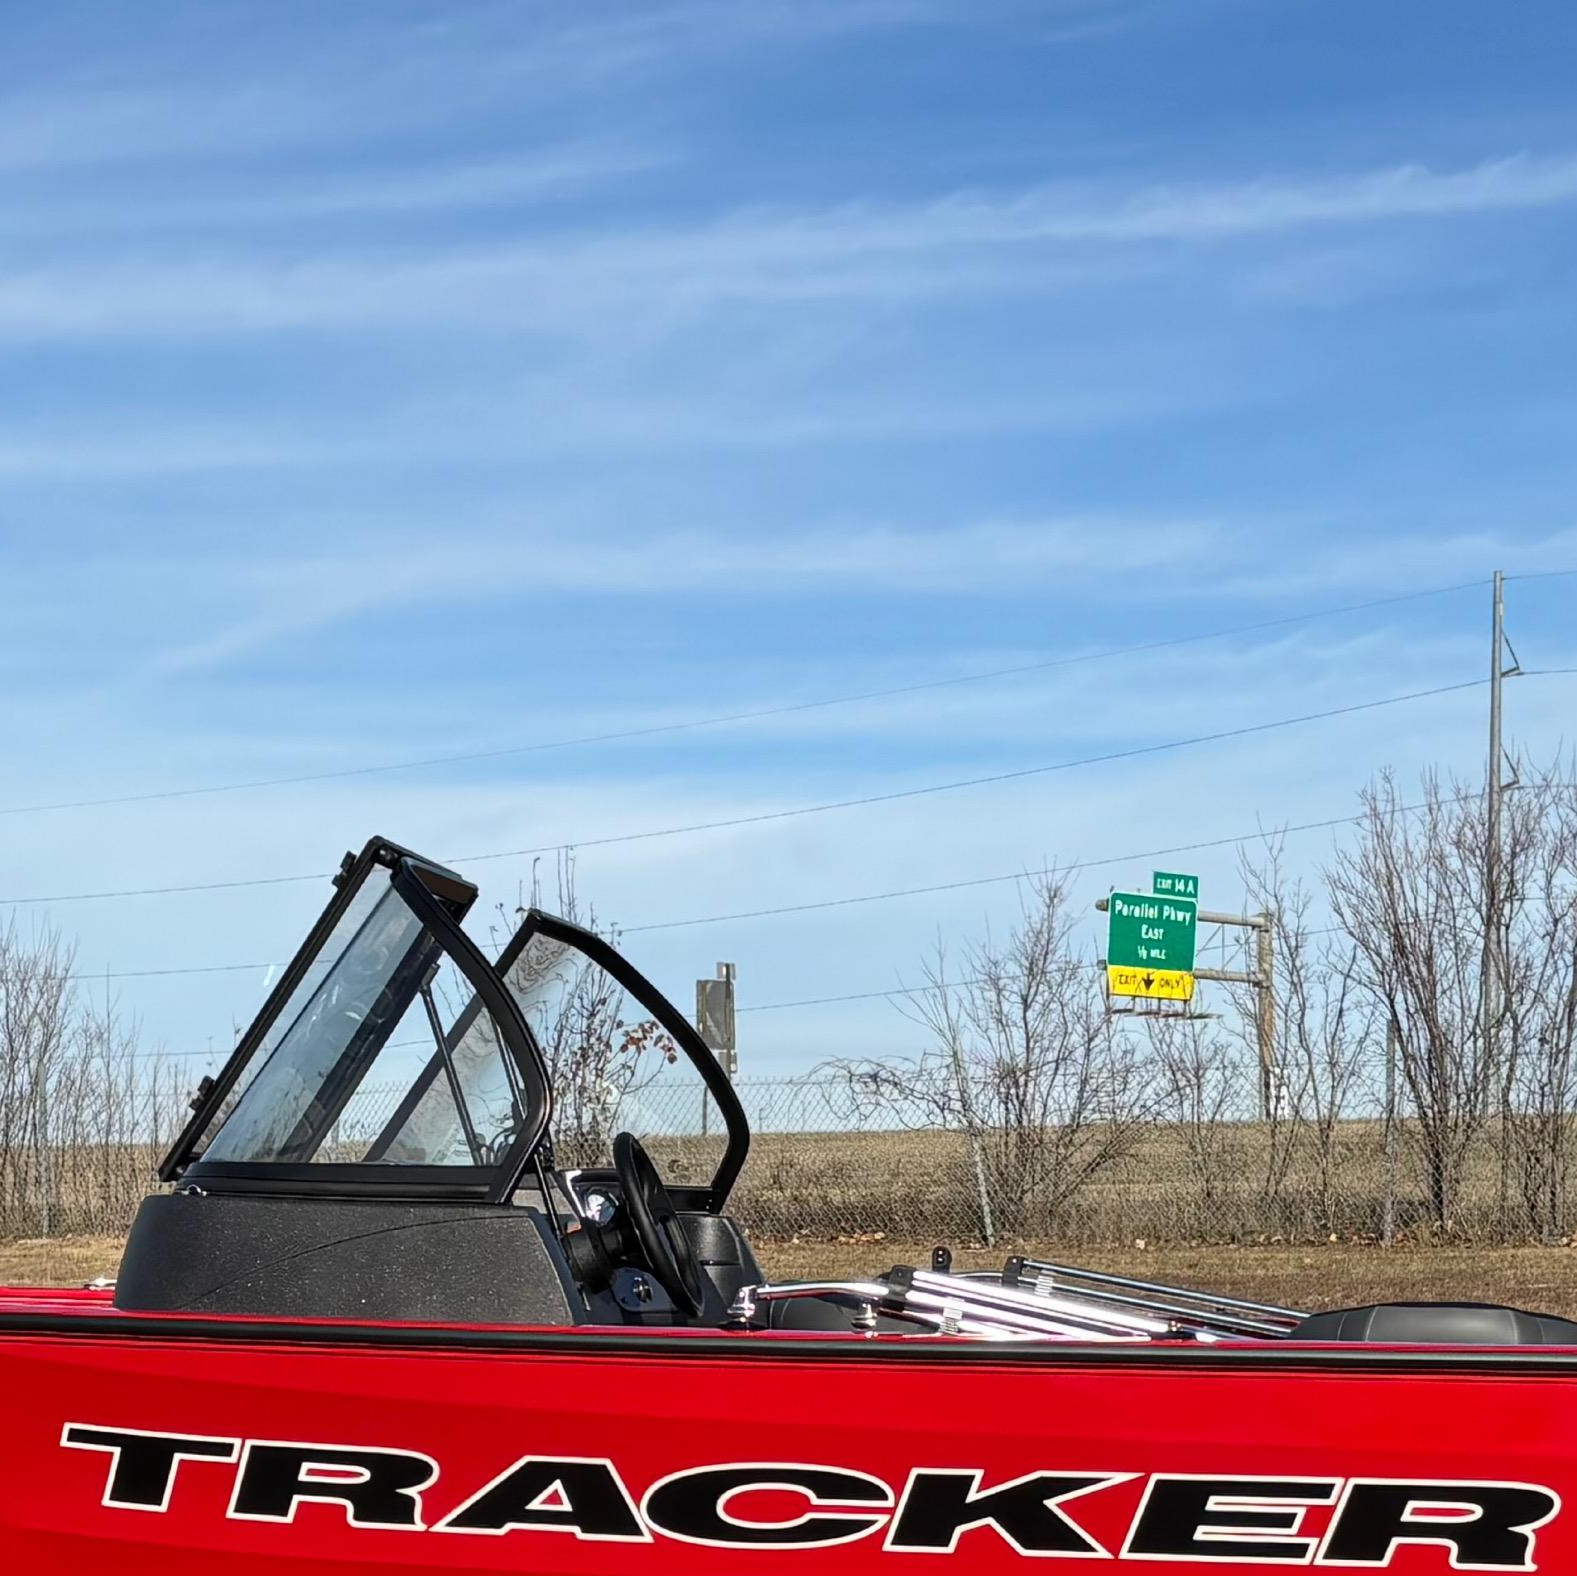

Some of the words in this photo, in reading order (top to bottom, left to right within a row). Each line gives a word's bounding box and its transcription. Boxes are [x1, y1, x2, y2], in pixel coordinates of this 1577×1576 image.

[1114, 899, 1159, 919] Parallel
[1163, 905, 1192, 927] Pkwy
[1141, 924, 1164, 940] EAST
[1118, 974, 1137, 985] EXIT
[1159, 978, 1181, 990] ONLY
[60, 1423, 1562, 1572] TRACKER
